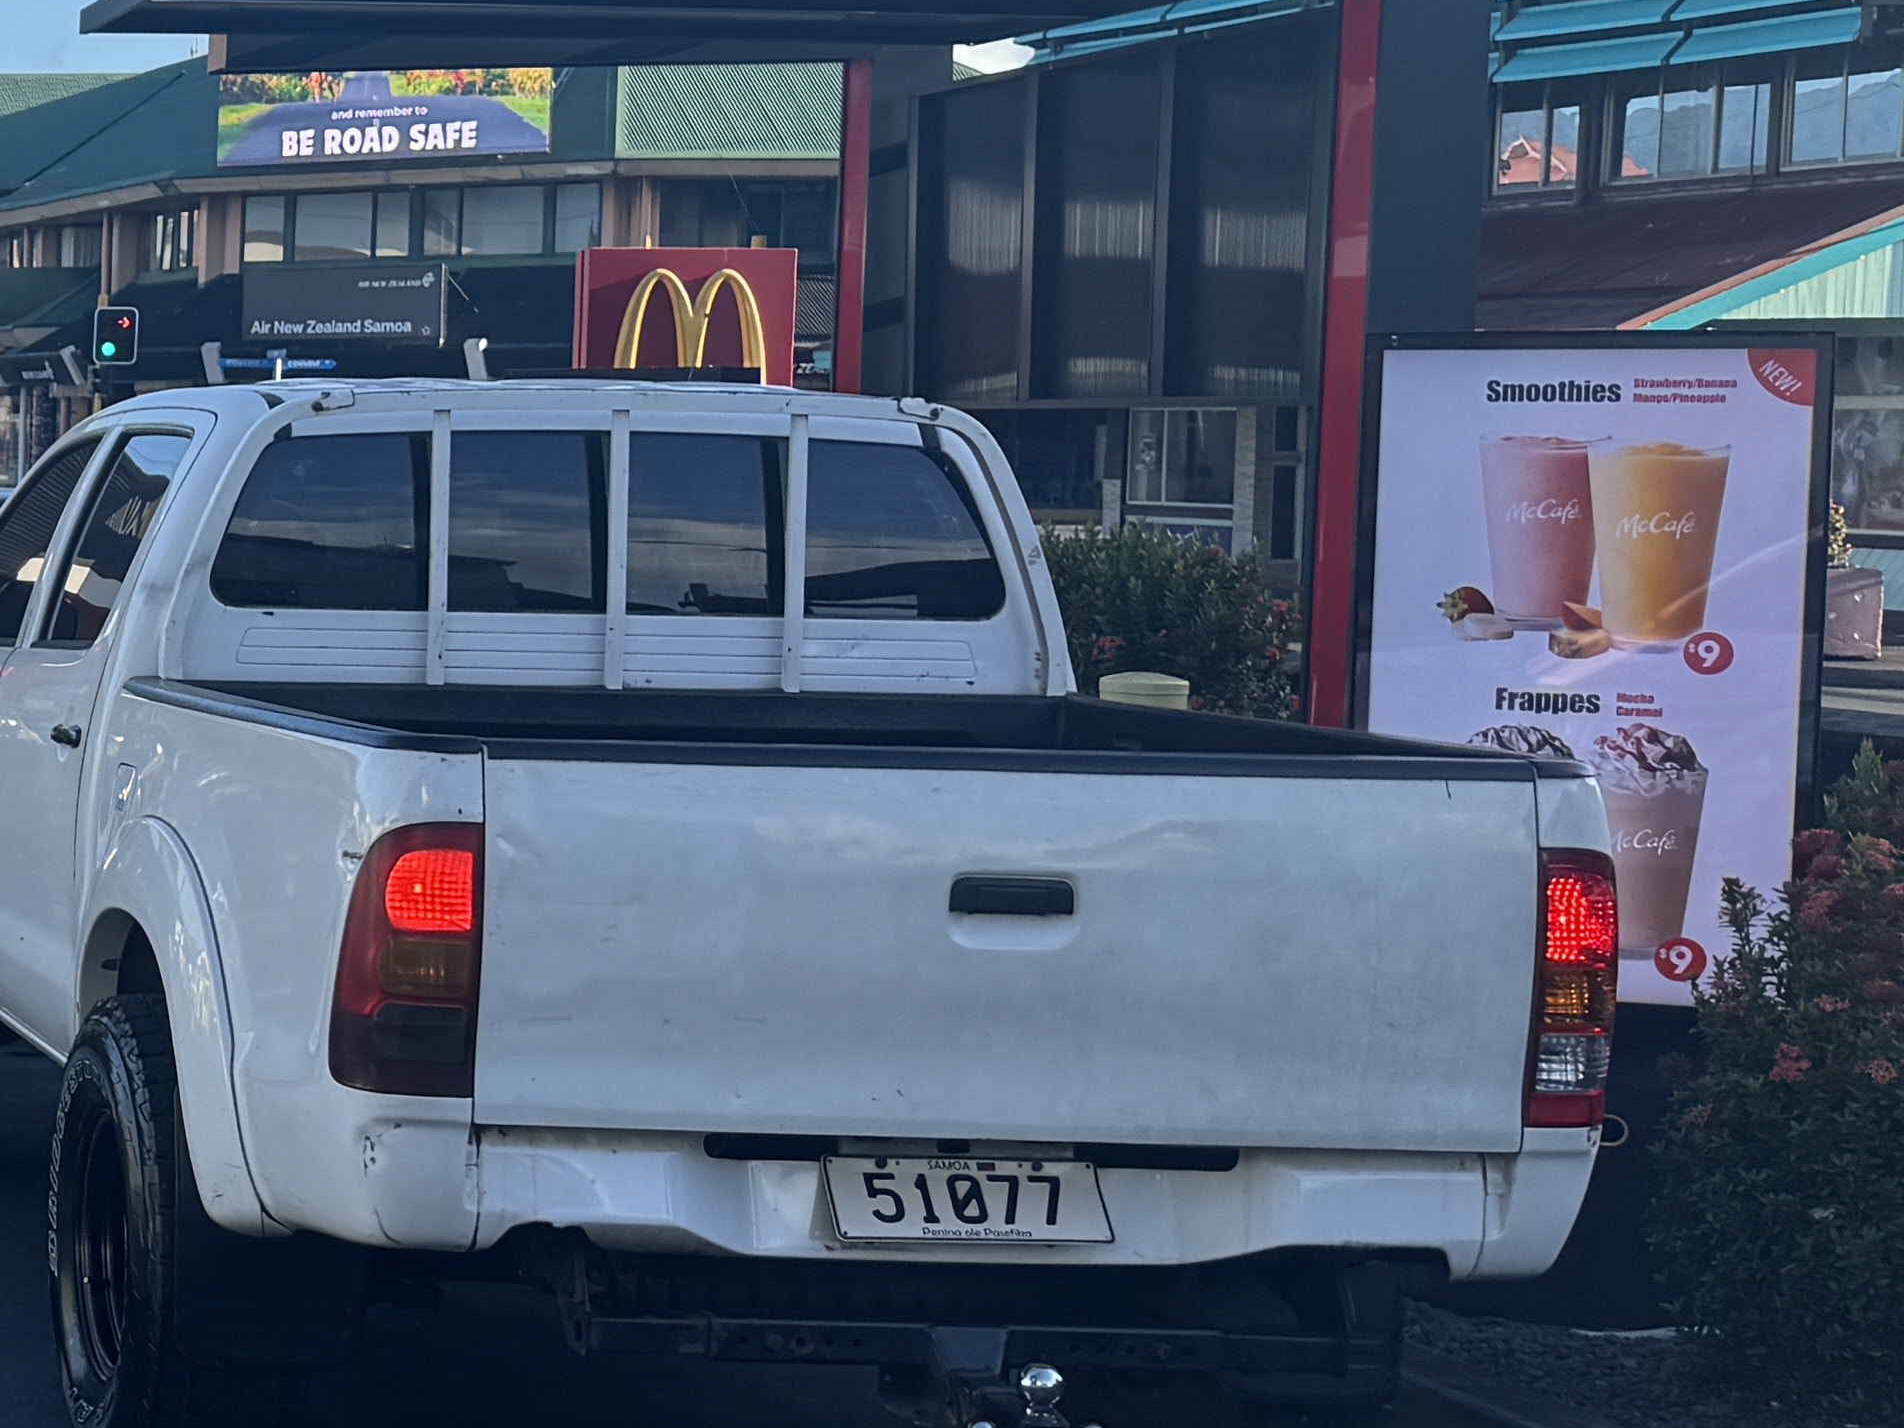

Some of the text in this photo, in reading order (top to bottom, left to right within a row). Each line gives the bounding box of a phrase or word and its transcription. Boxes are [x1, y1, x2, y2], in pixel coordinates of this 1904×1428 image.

[331, 106, 428, 120] and remember to
[281, 121, 478, 157] BE ROAD SAFE
[251, 319, 412, 335] Air New Zealand Samoa
[1760, 359, 1803, 396] NEW!
[1486, 378, 1738, 404] Smoothies Strawberry/Banana
[1633, 392, 1727, 404] Mango/Pineapple
[1506, 498, 1580, 524] McCafé
[1615, 511, 1695, 540] McCafé
[1495, 687, 1601, 715] Frappes
[928, 1160, 971, 1171] SAMOA
[863, 1172, 1061, 1226] 51077
[922, 1226, 962, 1237] Penina
